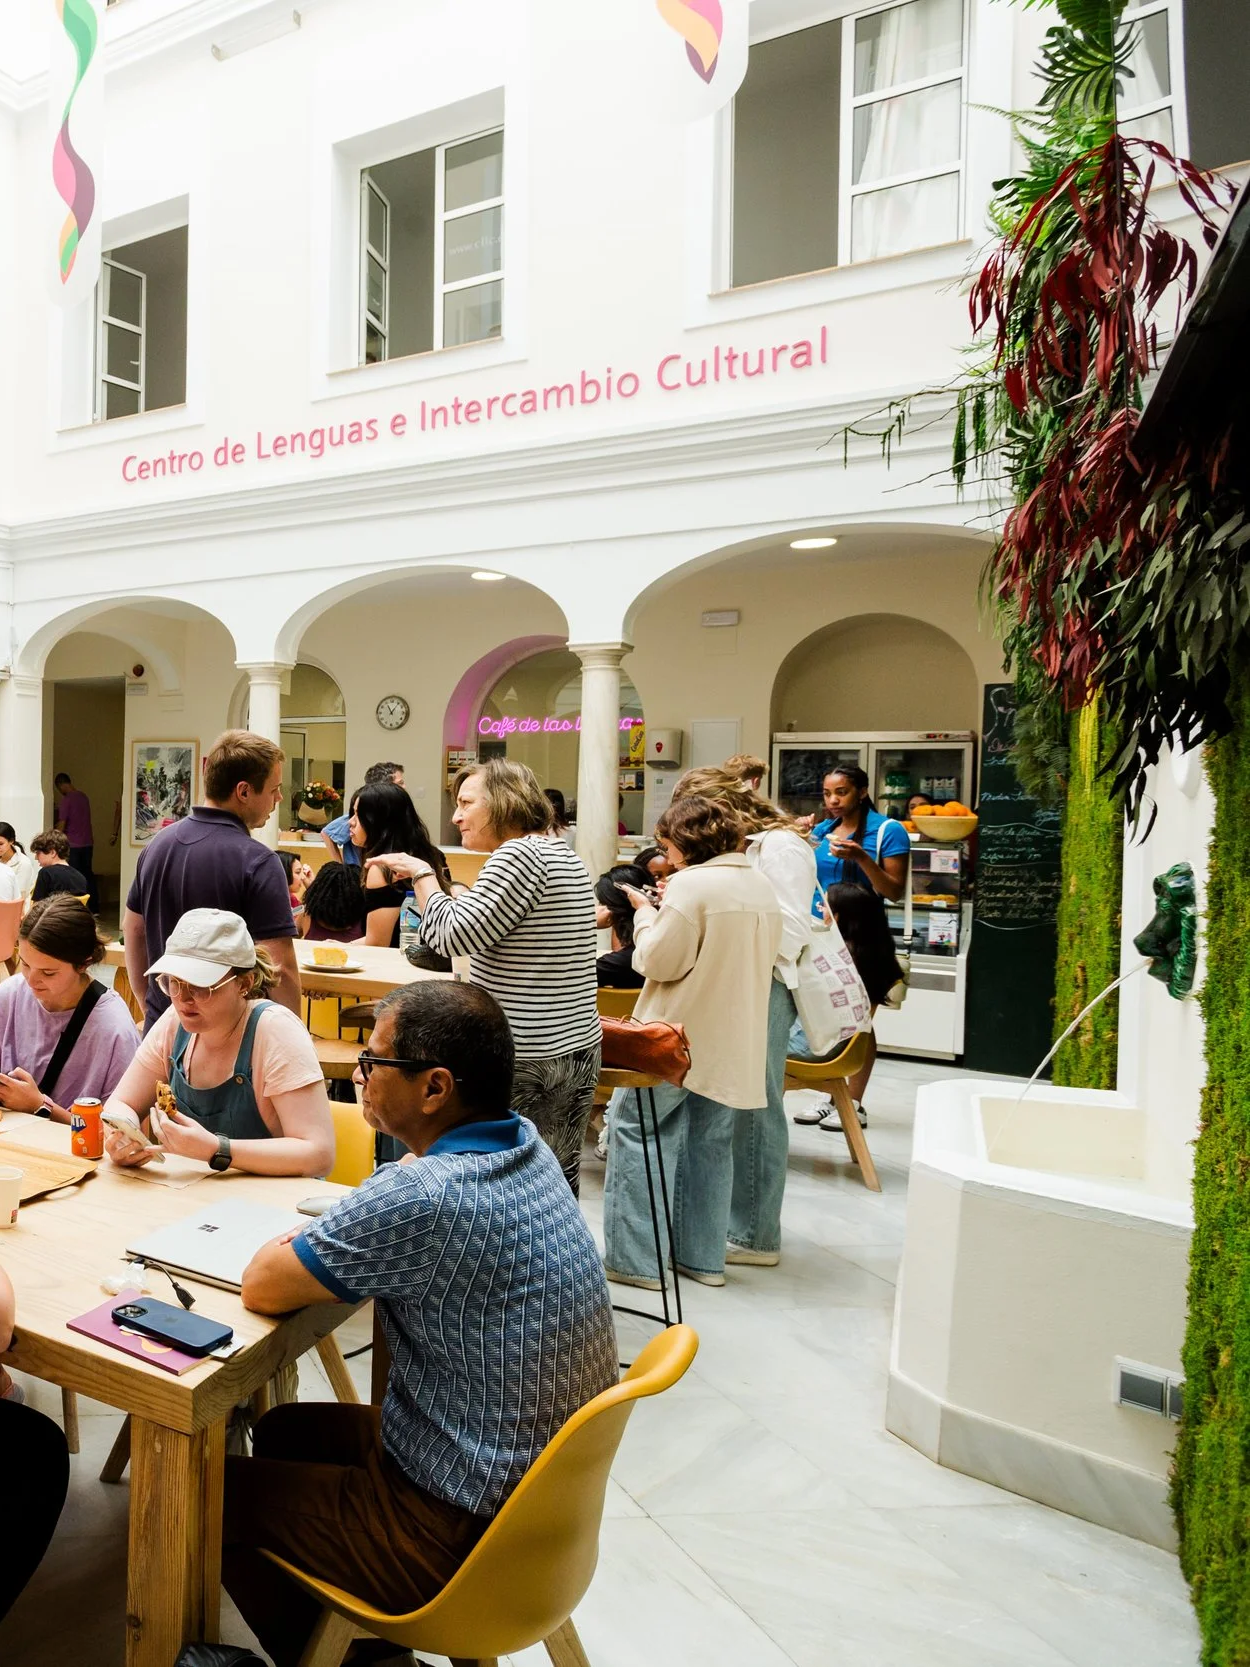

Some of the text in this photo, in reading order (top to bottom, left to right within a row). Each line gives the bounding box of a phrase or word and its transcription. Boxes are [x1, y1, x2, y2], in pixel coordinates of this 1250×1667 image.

[122, 326, 828, 483] Centro de Lenguas e Intercambio Cultural
[478, 716, 517, 738] Café
[518, 716, 540, 732] de
[543, 716, 572, 732] las
